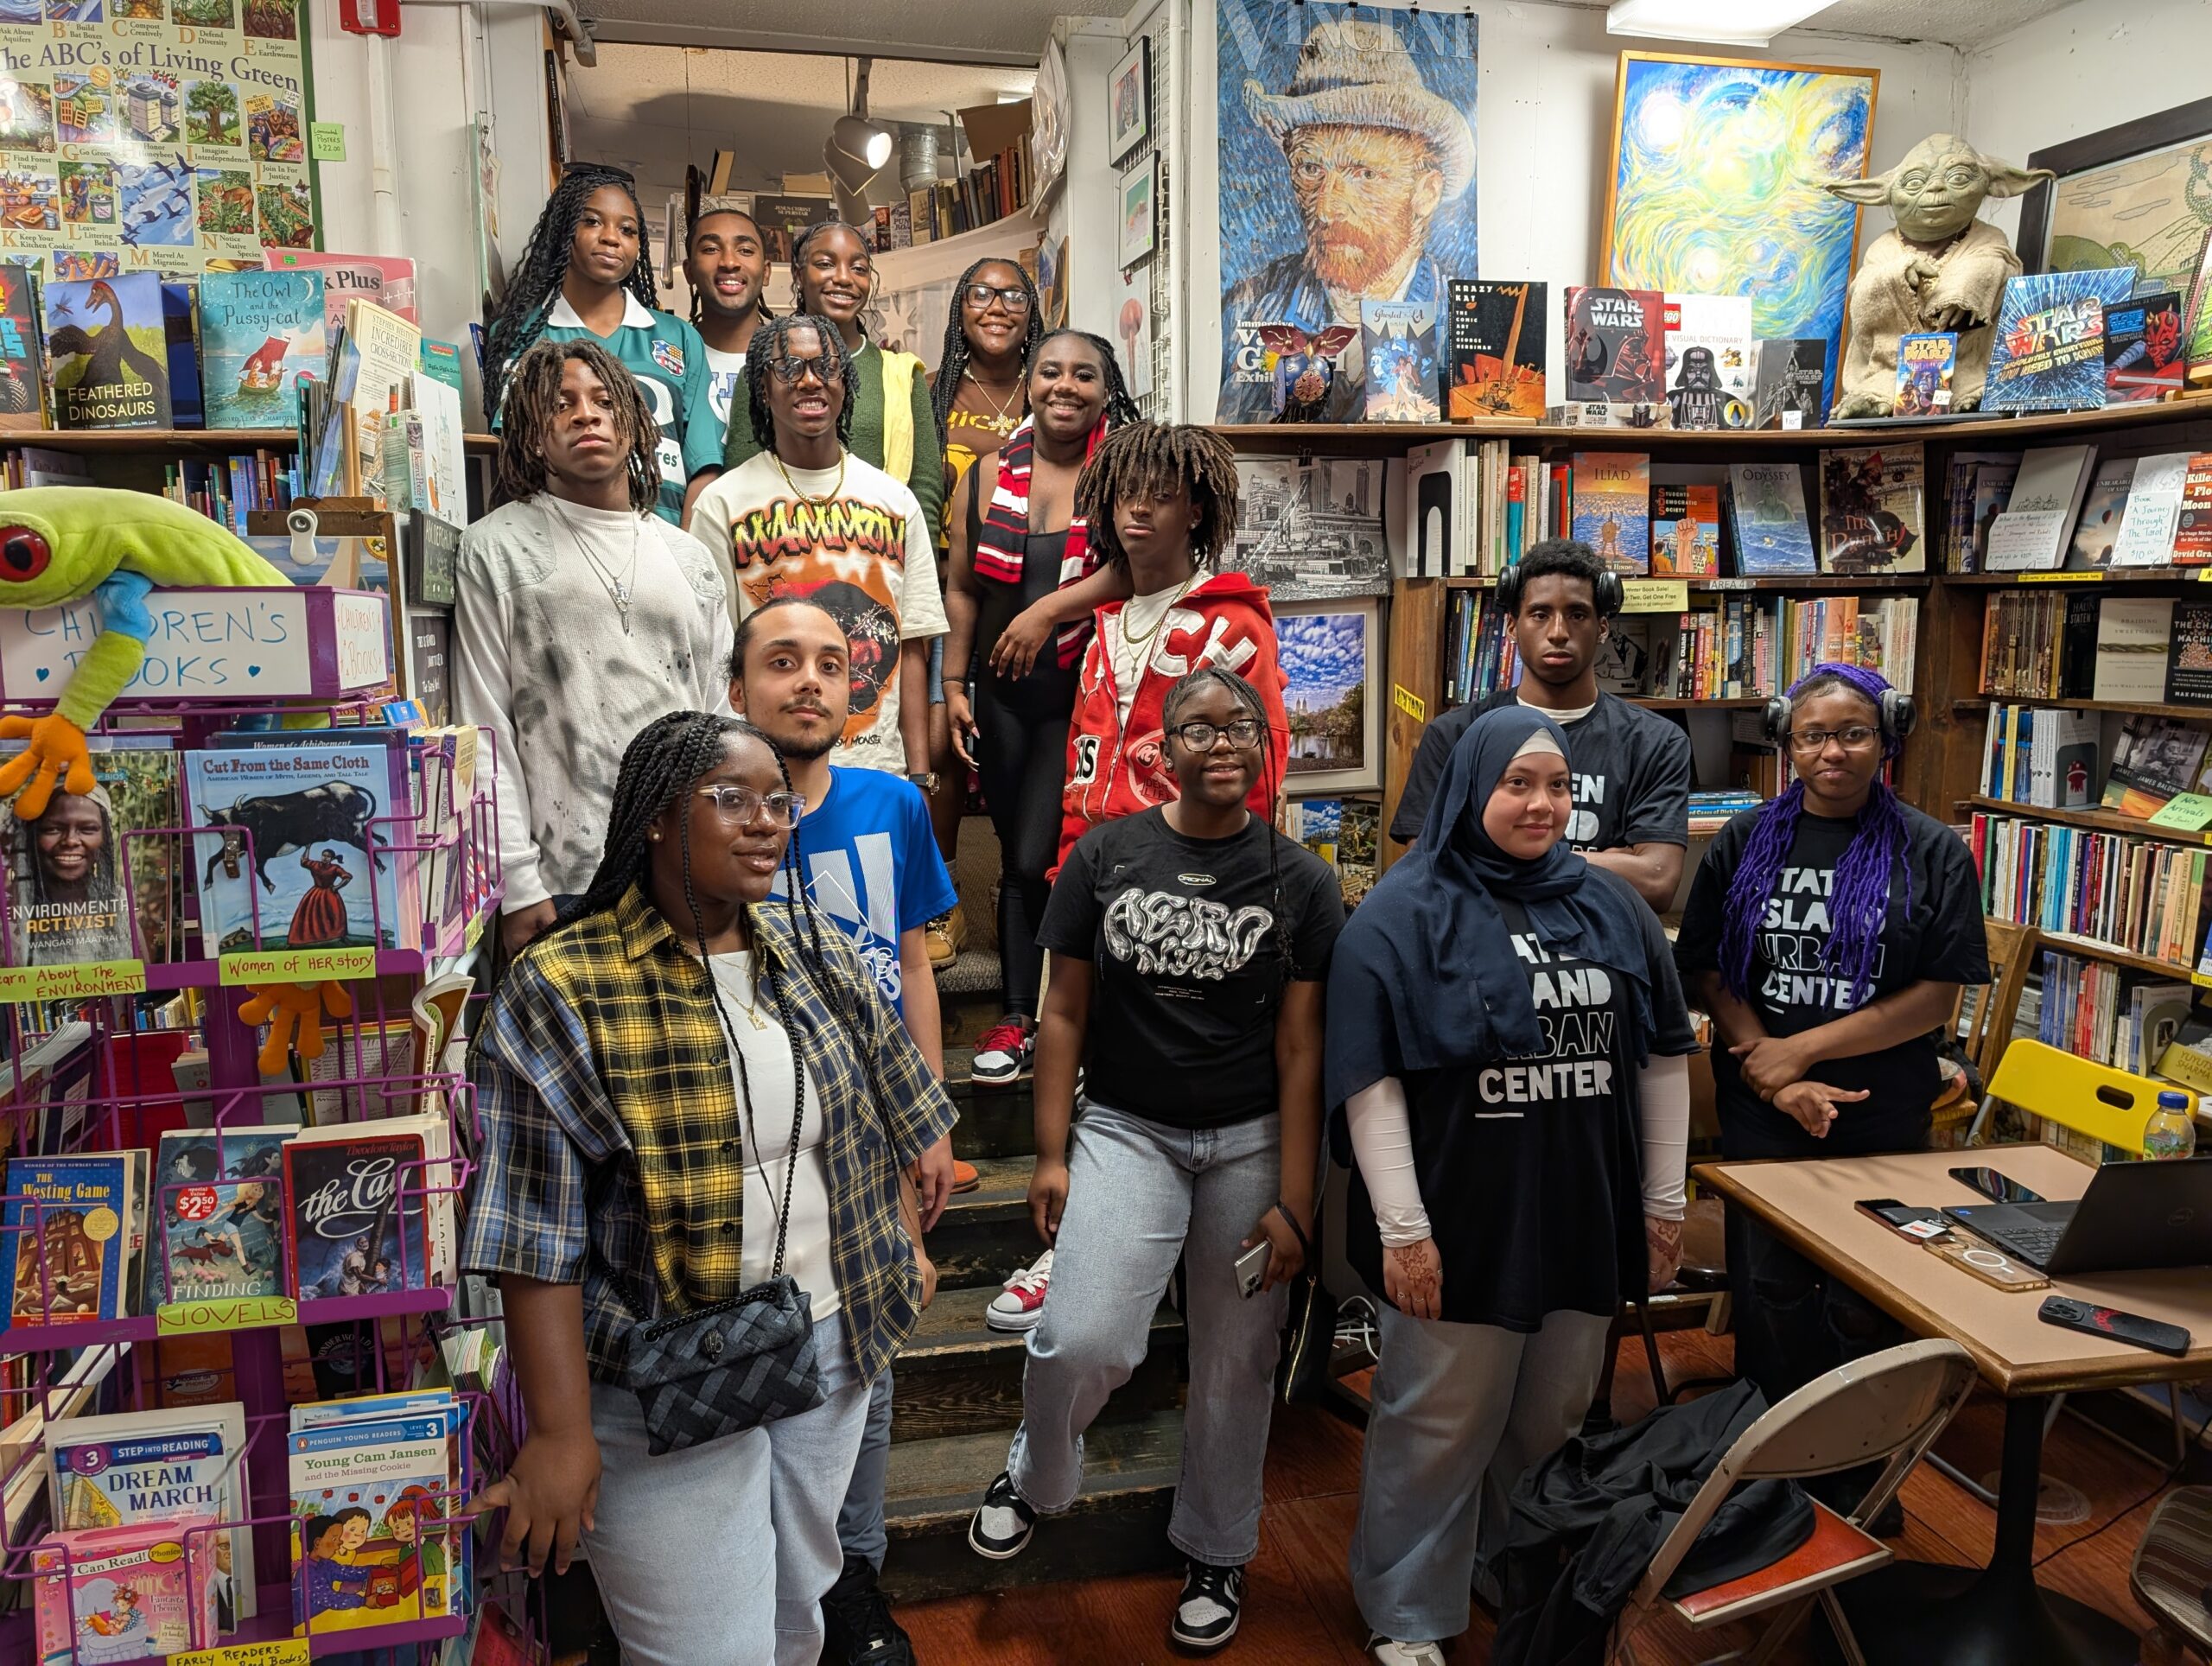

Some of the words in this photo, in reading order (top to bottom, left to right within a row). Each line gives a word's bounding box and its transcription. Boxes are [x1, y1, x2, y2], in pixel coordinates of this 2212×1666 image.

[130, 22, 160, 30] Compost
[130, 29, 162, 38] Creatively
[198, 36, 227, 47] Diversity
[1218, 0, 1478, 71] VINCENT
[258, 49, 298, 60] Earthworms
[266, 43, 284, 53] Enjoy
[38, 41, 111, 67] ABC's
[118, 41, 143, 66] of
[149, 44, 224, 82] Living
[230, 56, 299, 92] Green
[194, 154, 249, 164] Interdependence
[201, 147, 229, 156] Imagine
[17, 163, 38, 172] Fungi
[20, 233, 36, 242] Keep
[38, 233, 54, 242] Your
[84, 232, 113, 241] Littering
[152, 258, 188, 267] Migrations
[336, 270, 381, 290] Plus
[1455, 284, 1493, 293] KRAZY
[231, 282, 259, 299] The
[262, 281, 292, 298] Owl
[1590, 297, 1644, 313] STAR
[223, 304, 302, 333] Pussy-cat
[1591, 312, 1644, 327] WARS
[2017, 296, 2103, 334] STAR
[372, 326, 413, 357] INCREDIBLE
[1700, 335, 1744, 345] DICTIONARY
[1910, 339, 1950, 351] STAR
[2005, 314, 2104, 359] WARS
[370, 342, 412, 369] CROSS-SECTIONS
[1904, 344, 1953, 360] WARS
[67, 382, 153, 402] FEATHERED
[68, 400, 156, 422] DINOSAURS
[1594, 467, 1631, 481] ILIAD
[1742, 468, 1791, 481] ODYSSEY
[1657, 487, 1690, 498] STUDENTS
[1658, 498, 1698, 506] DEMOCRATIC
[2182, 499, 2211, 511] Moon
[1657, 506, 1686, 516] SOCIETY
[2131, 516, 2164, 528] Through
[1711, 580, 1736, 589] AREA
[1738, 580, 1745, 588] 4
[340, 603, 377, 634] CHILDREN'S
[347, 640, 378, 679] BOOKS
[203, 759, 228, 774] Cut
[230, 758, 266, 773] From
[269, 758, 290, 772] the
[293, 756, 329, 771] Same
[332, 754, 370, 770] Cloth
[2137, 775, 2156, 787] JAMES
[2180, 796, 2202, 805] New
[2165, 804, 2206, 818] Arrivals
[2072, 864, 2081, 908] PARADIGM
[26, 912, 118, 934] ACTIVIST
[29, 937, 75, 950] WANGARI
[76, 934, 118, 945] MAATHAI
[228, 957, 275, 978] Women
[283, 955, 300, 974] of
[36, 974, 145, 999] ENVIRONMENT
[1532, 968, 1612, 1009] AND
[2175, 1059, 2212, 1080] SHARMA
[1478, 1059, 1613, 1103] CENTER
[346, 1143, 388, 1156] Theodore
[389, 1141, 417, 1154] Taylor
[36, 1173, 54, 1184] THE
[22, 1183, 73, 1202] Westing
[76, 1182, 111, 1199] Game
[173, 1281, 262, 1300] FINDING
[158, 1299, 296, 1329] NOVELS
[309, 1436, 343, 1447] PENGUIN
[344, 1433, 371, 1443] YOUNG
[372, 1429, 402, 1440] READERS
[425, 1421, 438, 1438] 3
[118, 1447, 144, 1459] STEP
[144, 1445, 162, 1454] INTO
[162, 1439, 210, 1453] READING
[86, 1451, 99, 1468] 3
[304, 1456, 352, 1471] Young
[353, 1453, 387, 1464] Cam
[389, 1447, 437, 1461] Jansen
[108, 1465, 194, 1493] DREAM
[304, 1472, 323, 1482] and
[324, 1470, 340, 1479] the
[341, 1466, 378, 1478] Missing
[379, 1462, 411, 1474] Cookie
[129, 1485, 213, 1512] MARCH
[150, 1548, 181, 1559] Phonics
[77, 1562, 105, 1575] Can
[108, 1550, 149, 1569] Read!
